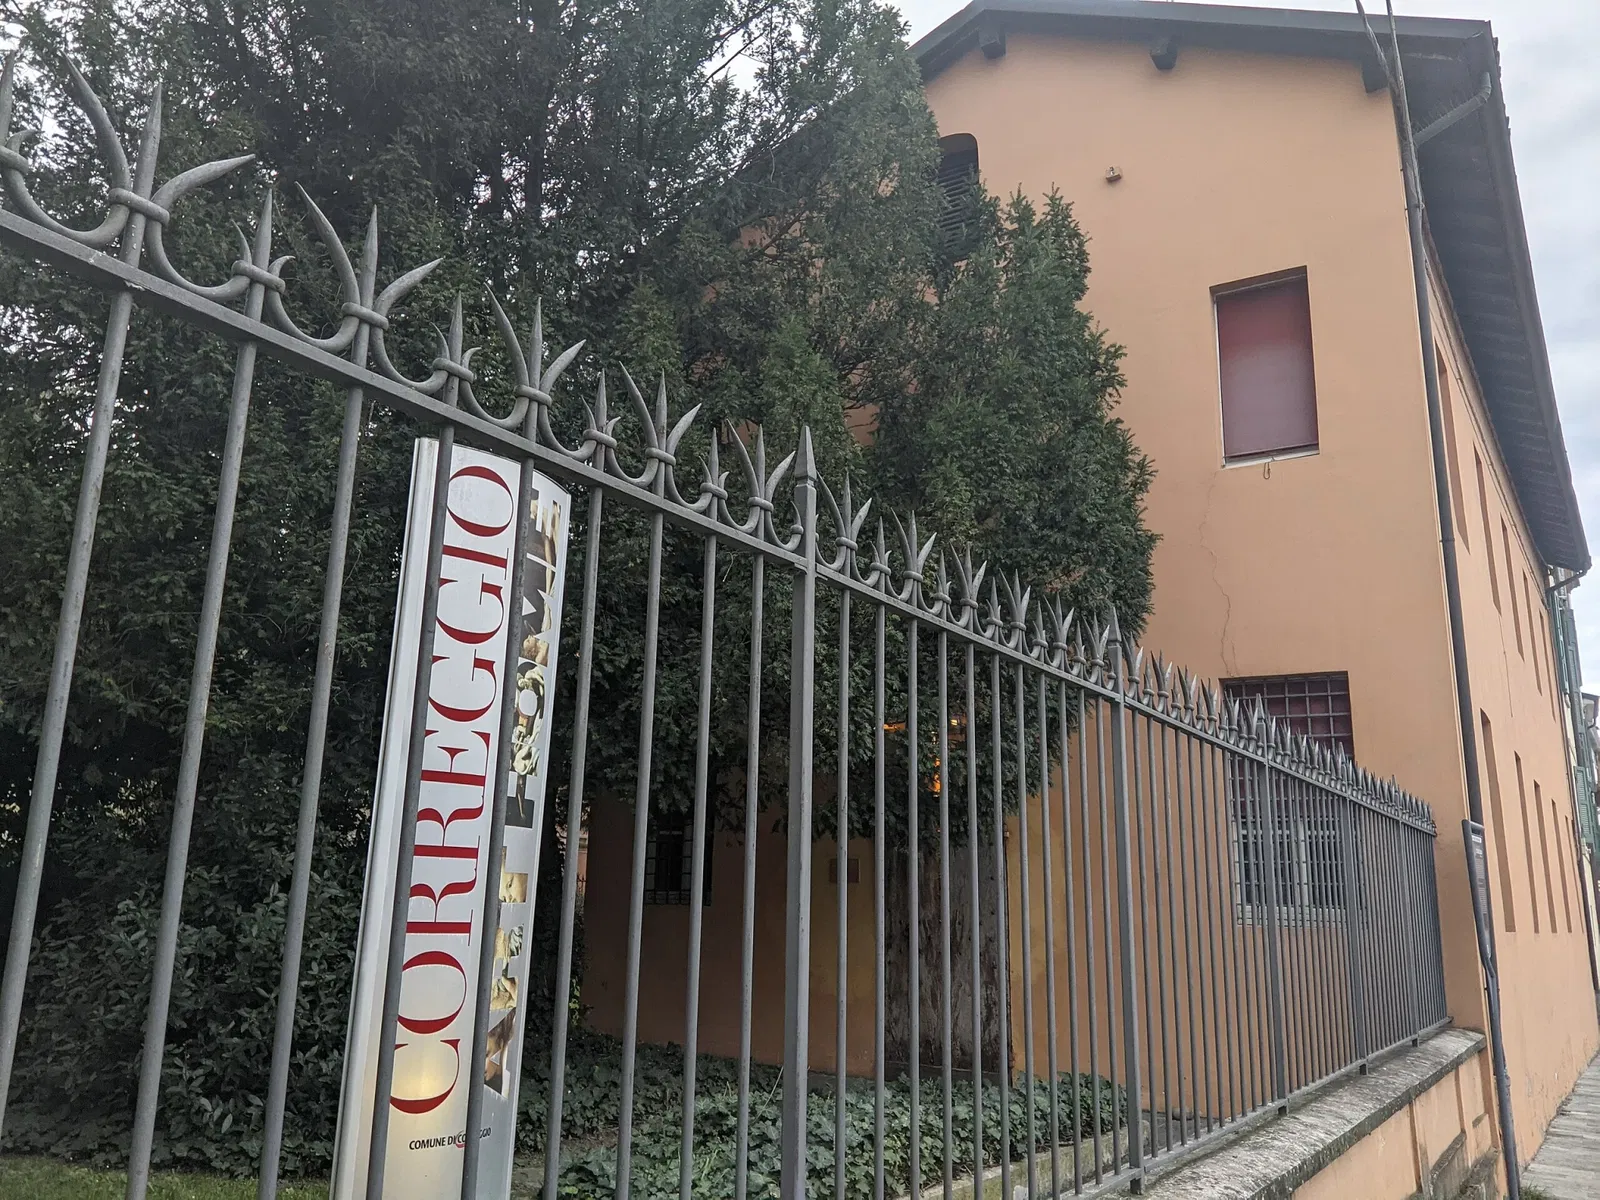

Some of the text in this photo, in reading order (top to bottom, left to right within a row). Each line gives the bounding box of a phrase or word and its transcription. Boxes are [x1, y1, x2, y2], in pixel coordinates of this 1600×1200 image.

[390, 465, 514, 1113] CORREGGIO
[505, 490, 561, 828] HOME
[409, 1136, 446, 1150] COMUNE
[447, 1135, 457, 1146] DI
